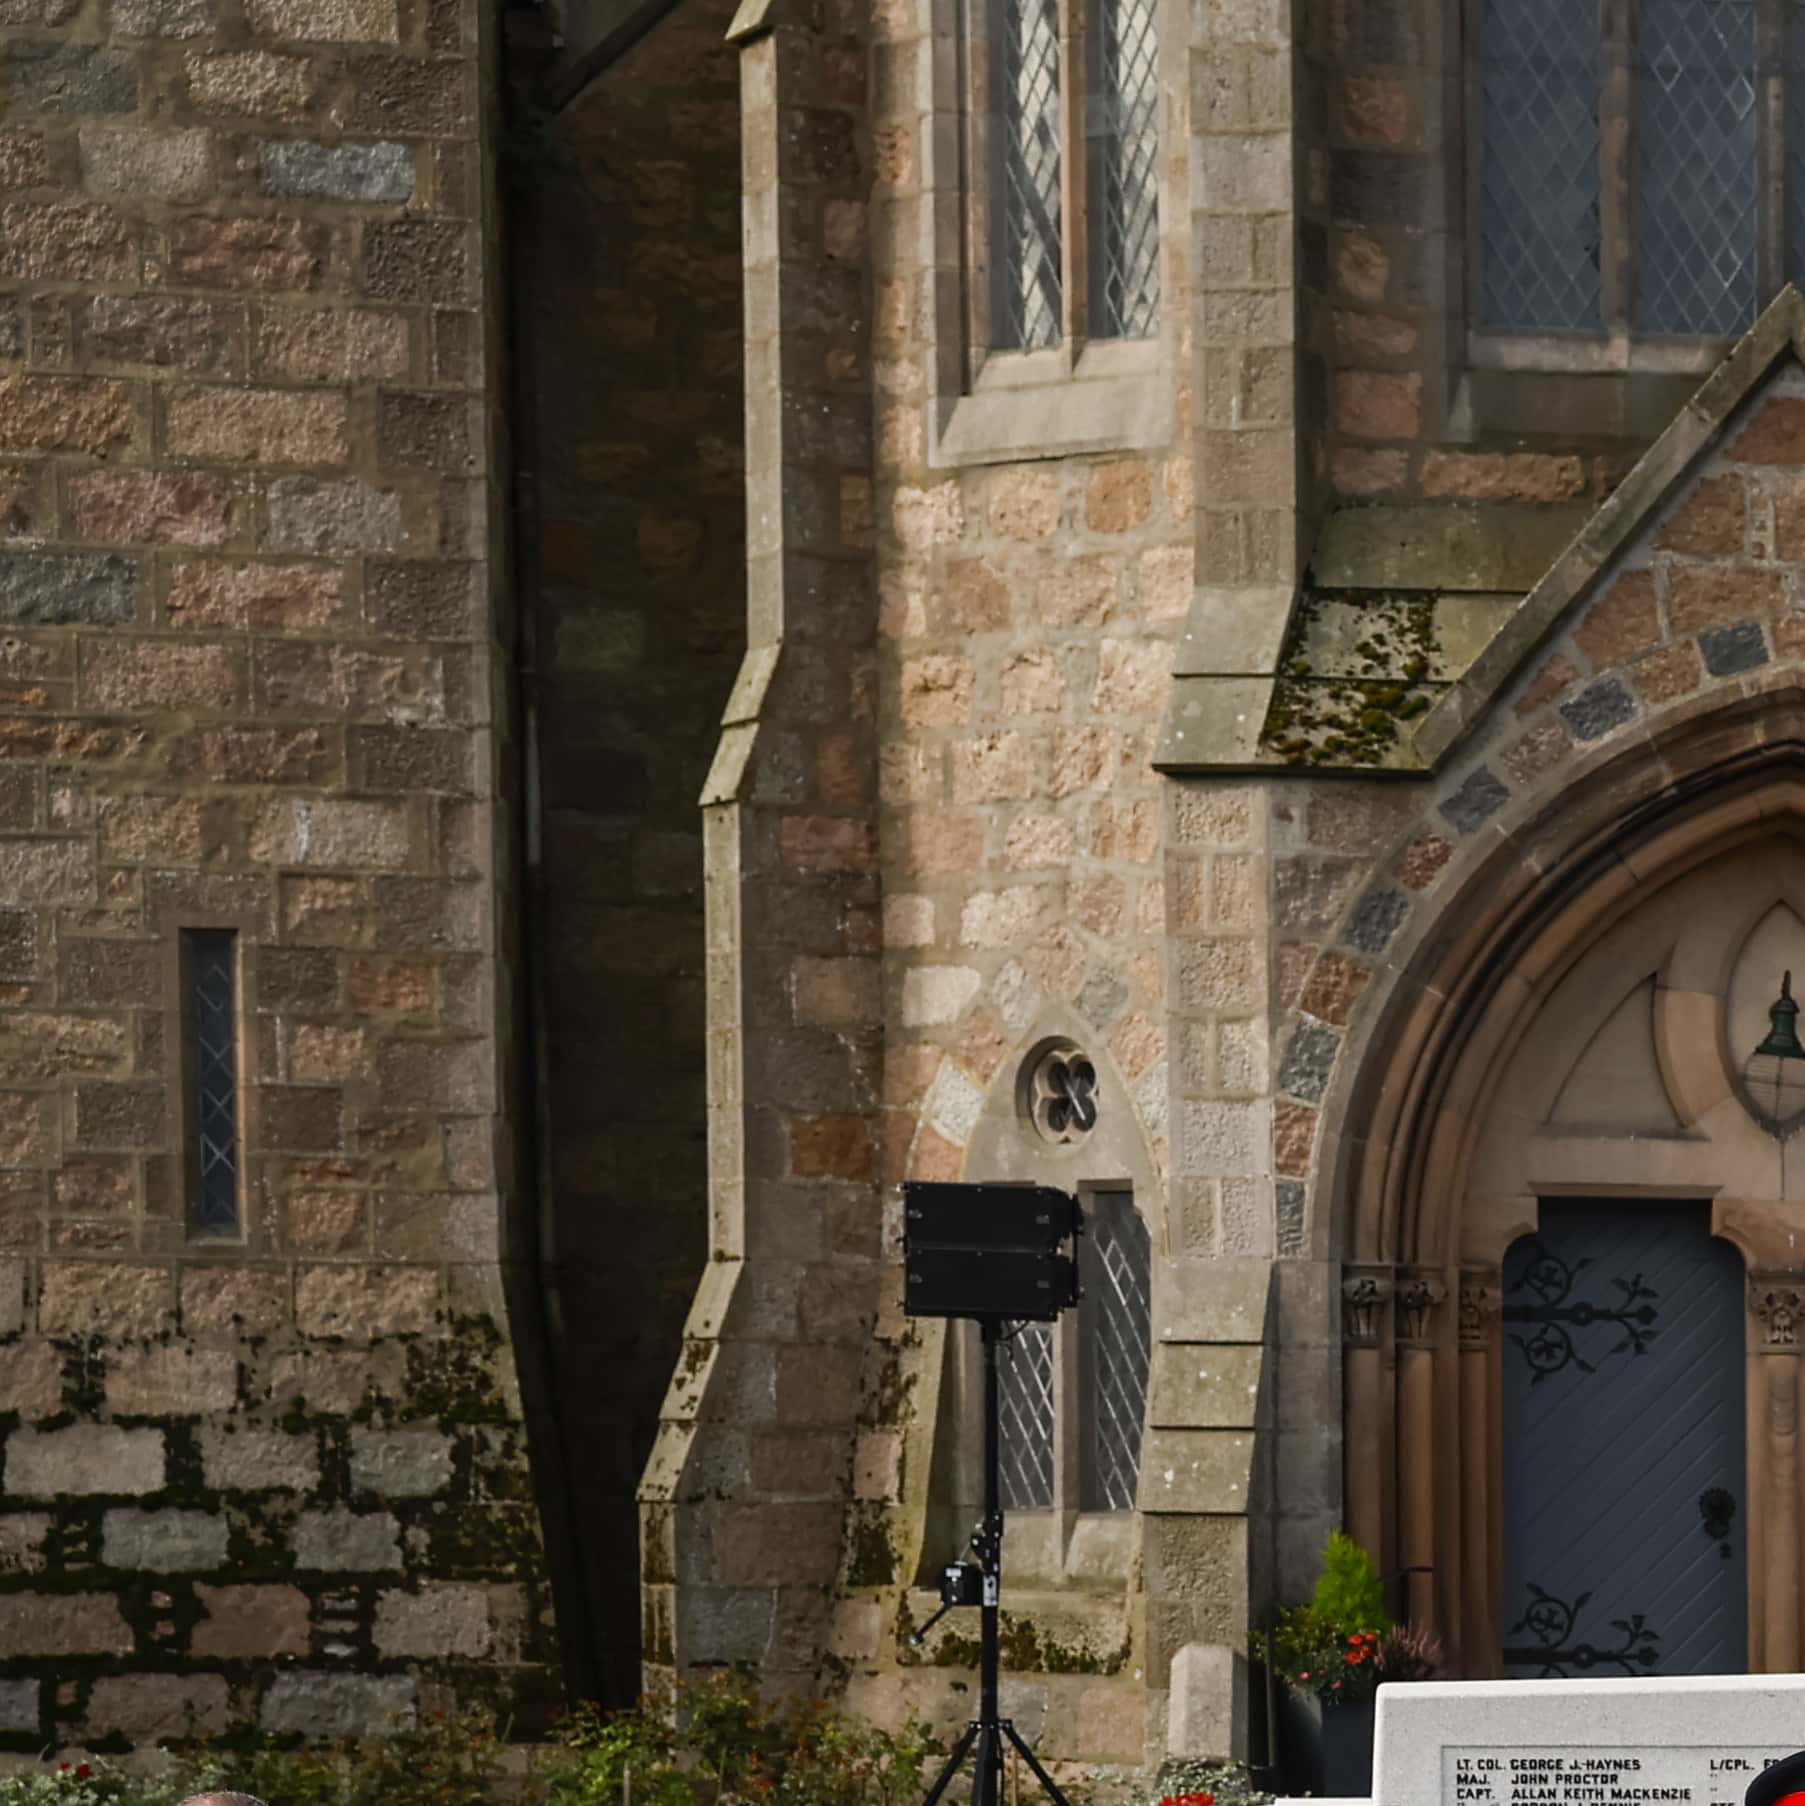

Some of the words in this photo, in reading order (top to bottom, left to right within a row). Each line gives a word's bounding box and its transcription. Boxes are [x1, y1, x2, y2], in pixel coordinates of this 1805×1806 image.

[1510, 1759, 1563, 1770] GEORGE
[1586, 1760, 1641, 1770] HAYNES
[1512, 1774, 1548, 1784] JOHN
[1556, 1774, 1618, 1784] PROCTOR
[1512, 1789, 1556, 1799] ALLAN
[1564, 1788, 1604, 1800] KEITH
[1611, 1789, 1690, 1800] MACKENZIE
